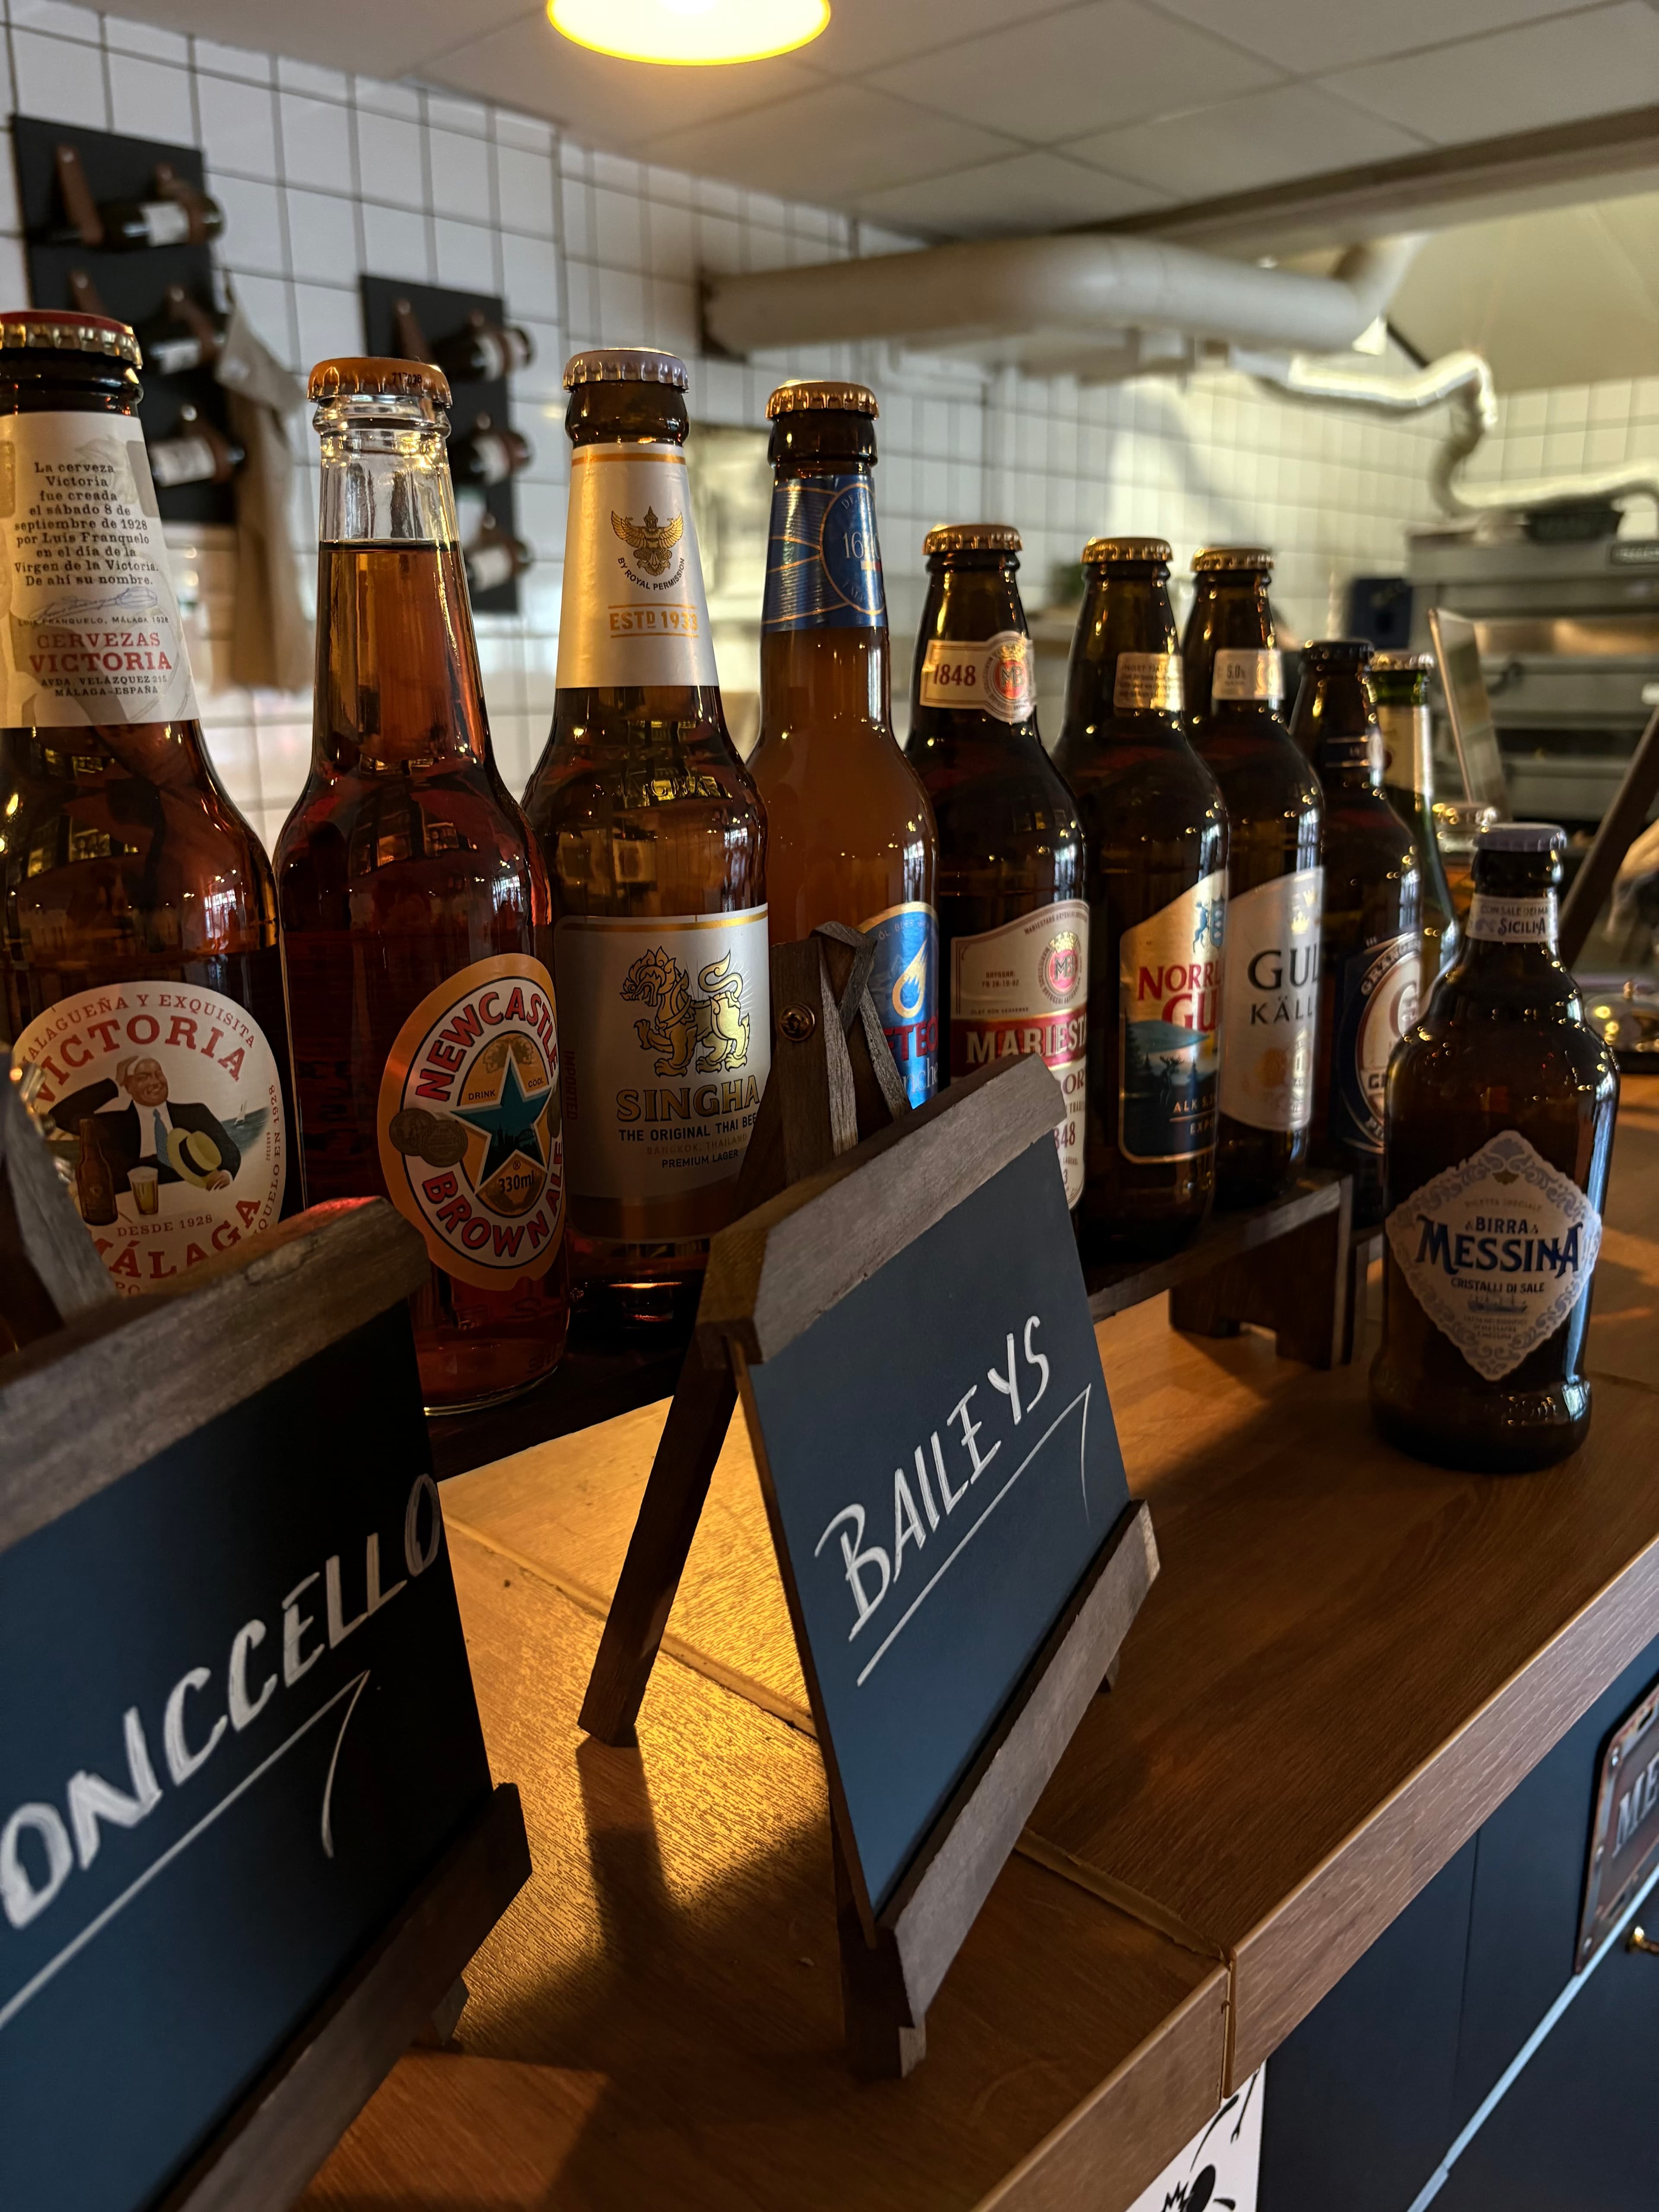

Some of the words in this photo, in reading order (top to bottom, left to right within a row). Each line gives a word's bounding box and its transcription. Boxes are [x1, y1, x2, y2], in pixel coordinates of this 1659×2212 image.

[35, 462, 53, 473] La
[58, 464, 114, 473] cerveza
[46, 476, 108, 486] Victoria
[40, 490, 63, 501] fue
[68, 490, 117, 501] creada
[30, 505, 41, 515] el
[47, 504, 100, 515] sábado
[105, 505, 111, 515] 8
[117, 505, 130, 515] de
[15, 518, 96, 532] septiembre
[102, 518, 117, 528] de
[121, 519, 147, 530] 1928
[16, 536, 38, 548] por
[42, 533, 76, 543] Luis
[82, 532, 149, 546] Franquelo
[37, 549, 52, 557] en
[58, 546, 70, 557] el
[76, 546, 100, 556] día
[105, 546, 121, 556] de
[124, 546, 136, 556] la
[15, 562, 59, 575] Virgen
[65, 560, 81, 571] de
[87, 560, 100, 570] la
[105, 560, 159, 571] Victoria.
[618, 557, 627, 569] BY
[625, 569, 651, 589] ROYAL
[653, 558, 685, 590] PERMISSION
[25, 575, 42, 586] De
[48, 575, 71, 585] ahí
[99, 575, 153, 585] nombre.
[661, 610, 698, 631] 1933
[37, 632, 160, 648] CERVEZAS
[29, 652, 172, 673] VICTORIA
[79, 675, 150, 685] VELÁZQUEZ
[933, 664, 976, 686] 1848
[1248, 944, 1317, 990] GUL
[1137, 959, 1222, 1001] NORRL
[136, 994, 150, 1007] Y
[159, 994, 255, 1049] EXQUISITA
[1162, 988, 1218, 1033] GU
[1251, 995, 1312, 1025] KÄLL
[415, 987, 559, 1102] NEWCASTLE
[966, 1014, 1087, 1064] MARIEST
[563, 1051, 578, 1120] IMPORTED
[902, 1058, 938, 1093] nche
[468, 1089, 495, 1100] DRINK
[528, 1077, 544, 1088] COOL
[616, 1074, 760, 1122] SINGHA
[269, 1084, 280, 1124] 1928
[1173, 1098, 1197, 1113] ALK
[619, 1130, 644, 1141] THE
[651, 1125, 710, 1140] ORIGINAL
[715, 1119, 738, 1134] THAI
[743, 1112, 757, 1128] BEE
[1054, 1122, 1075, 1150] 848
[274, 1132, 281, 1158] EN
[647, 1144, 702, 1155] BANGKOK,
[707, 1133, 747, 1149] THAILAND
[662, 1155, 709, 1168] PREMIUM
[712, 1149, 738, 1162] LAGER
[499, 1170, 534, 1194] 330ml
[255, 1164, 280, 1234] QUELO
[117, 1222, 173, 1236] DESDE
[179, 1214, 213, 1228] 1928
[422, 1170, 550, 1258] BROWN
[1476, 1216, 1528, 1234] BIRRA
[1416, 1214, 1583, 1278] MESSINA
[1451, 1278, 1503, 1293] CRISTALLI
[1506, 1282, 1516, 1293] DI
[1521, 1282, 1545, 1293] SALE
[814, 1316, 1050, 1642] BAILEYS
[0, 1473, 441, 1930] ONCCELLO
[1612, 1751, 1659, 1858] ME
